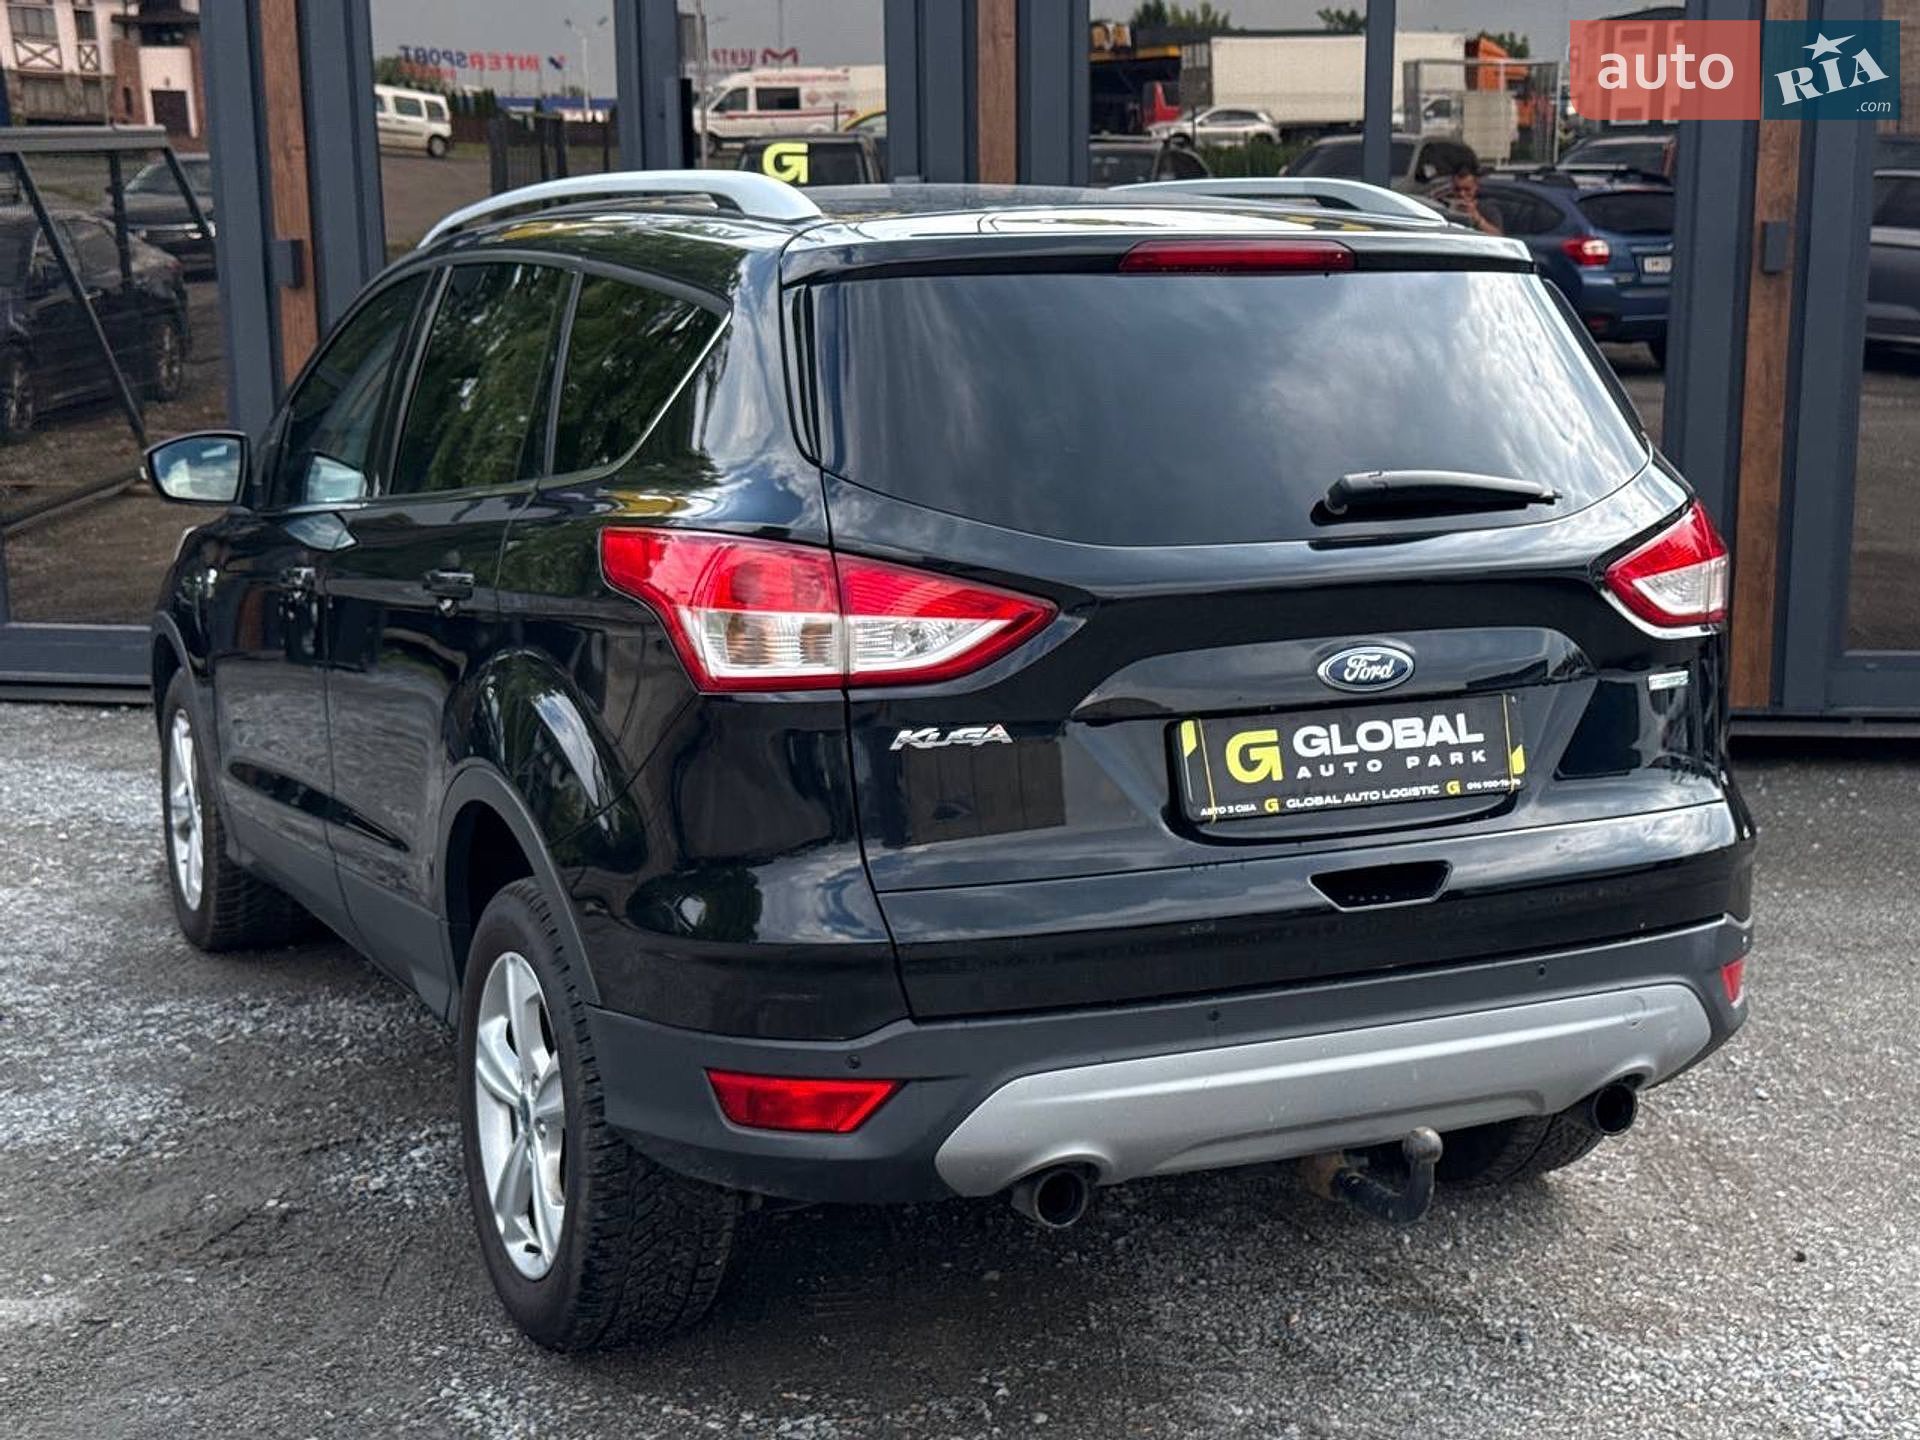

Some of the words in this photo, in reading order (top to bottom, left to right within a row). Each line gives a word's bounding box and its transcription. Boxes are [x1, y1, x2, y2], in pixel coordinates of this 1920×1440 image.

[1343, 654, 1395, 682] Ford
[889, 723, 1014, 751] KUGA
[1292, 712, 1485, 758] GLOBAL
[1296, 758, 1383, 780] AUTO
[1405, 749, 1486, 769] PARK
[1286, 794, 1342, 808] GLOBAL
[1344, 790, 1380, 802] AUTO
[1382, 784, 1440, 799] LOGISTIC
